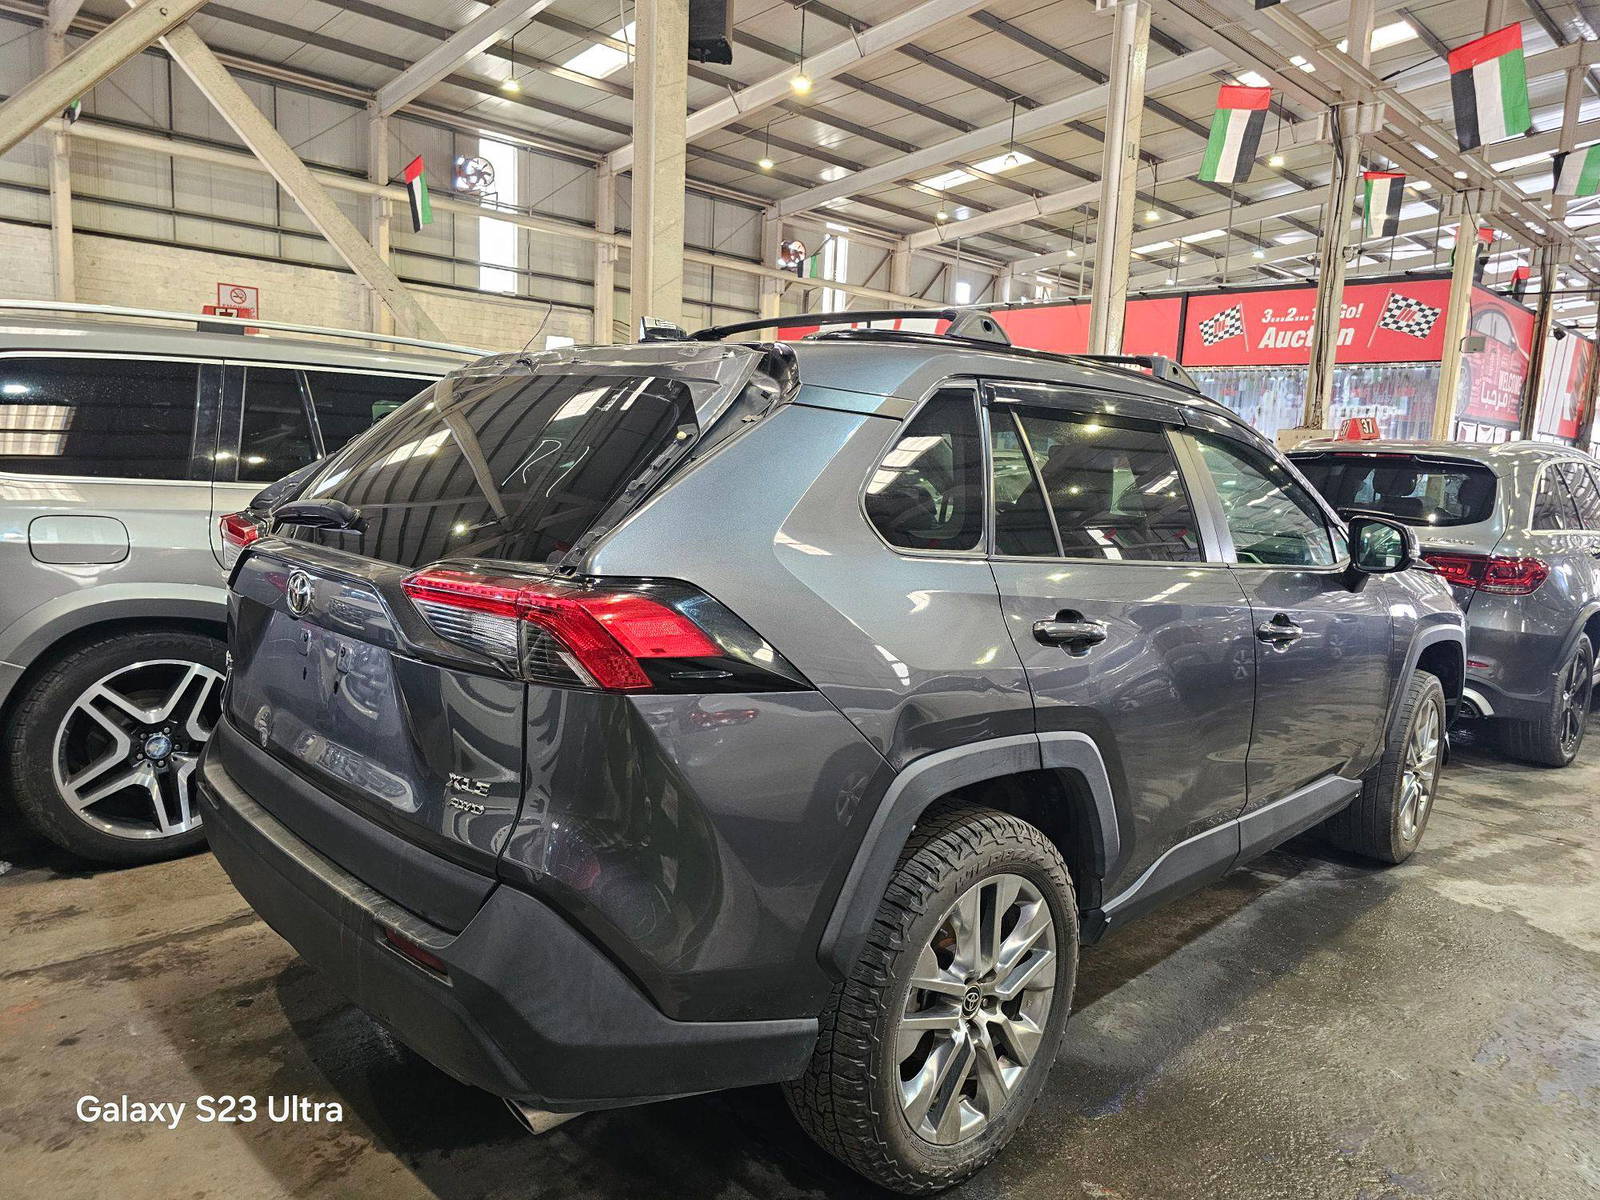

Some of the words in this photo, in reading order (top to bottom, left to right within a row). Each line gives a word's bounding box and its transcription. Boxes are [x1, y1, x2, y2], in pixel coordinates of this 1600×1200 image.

[1257, 326, 1355, 349] Auctn
[1360, 418, 1375, 434] 37
[445, 772, 491, 797] XLE
[447, 797, 485, 815] AWD
